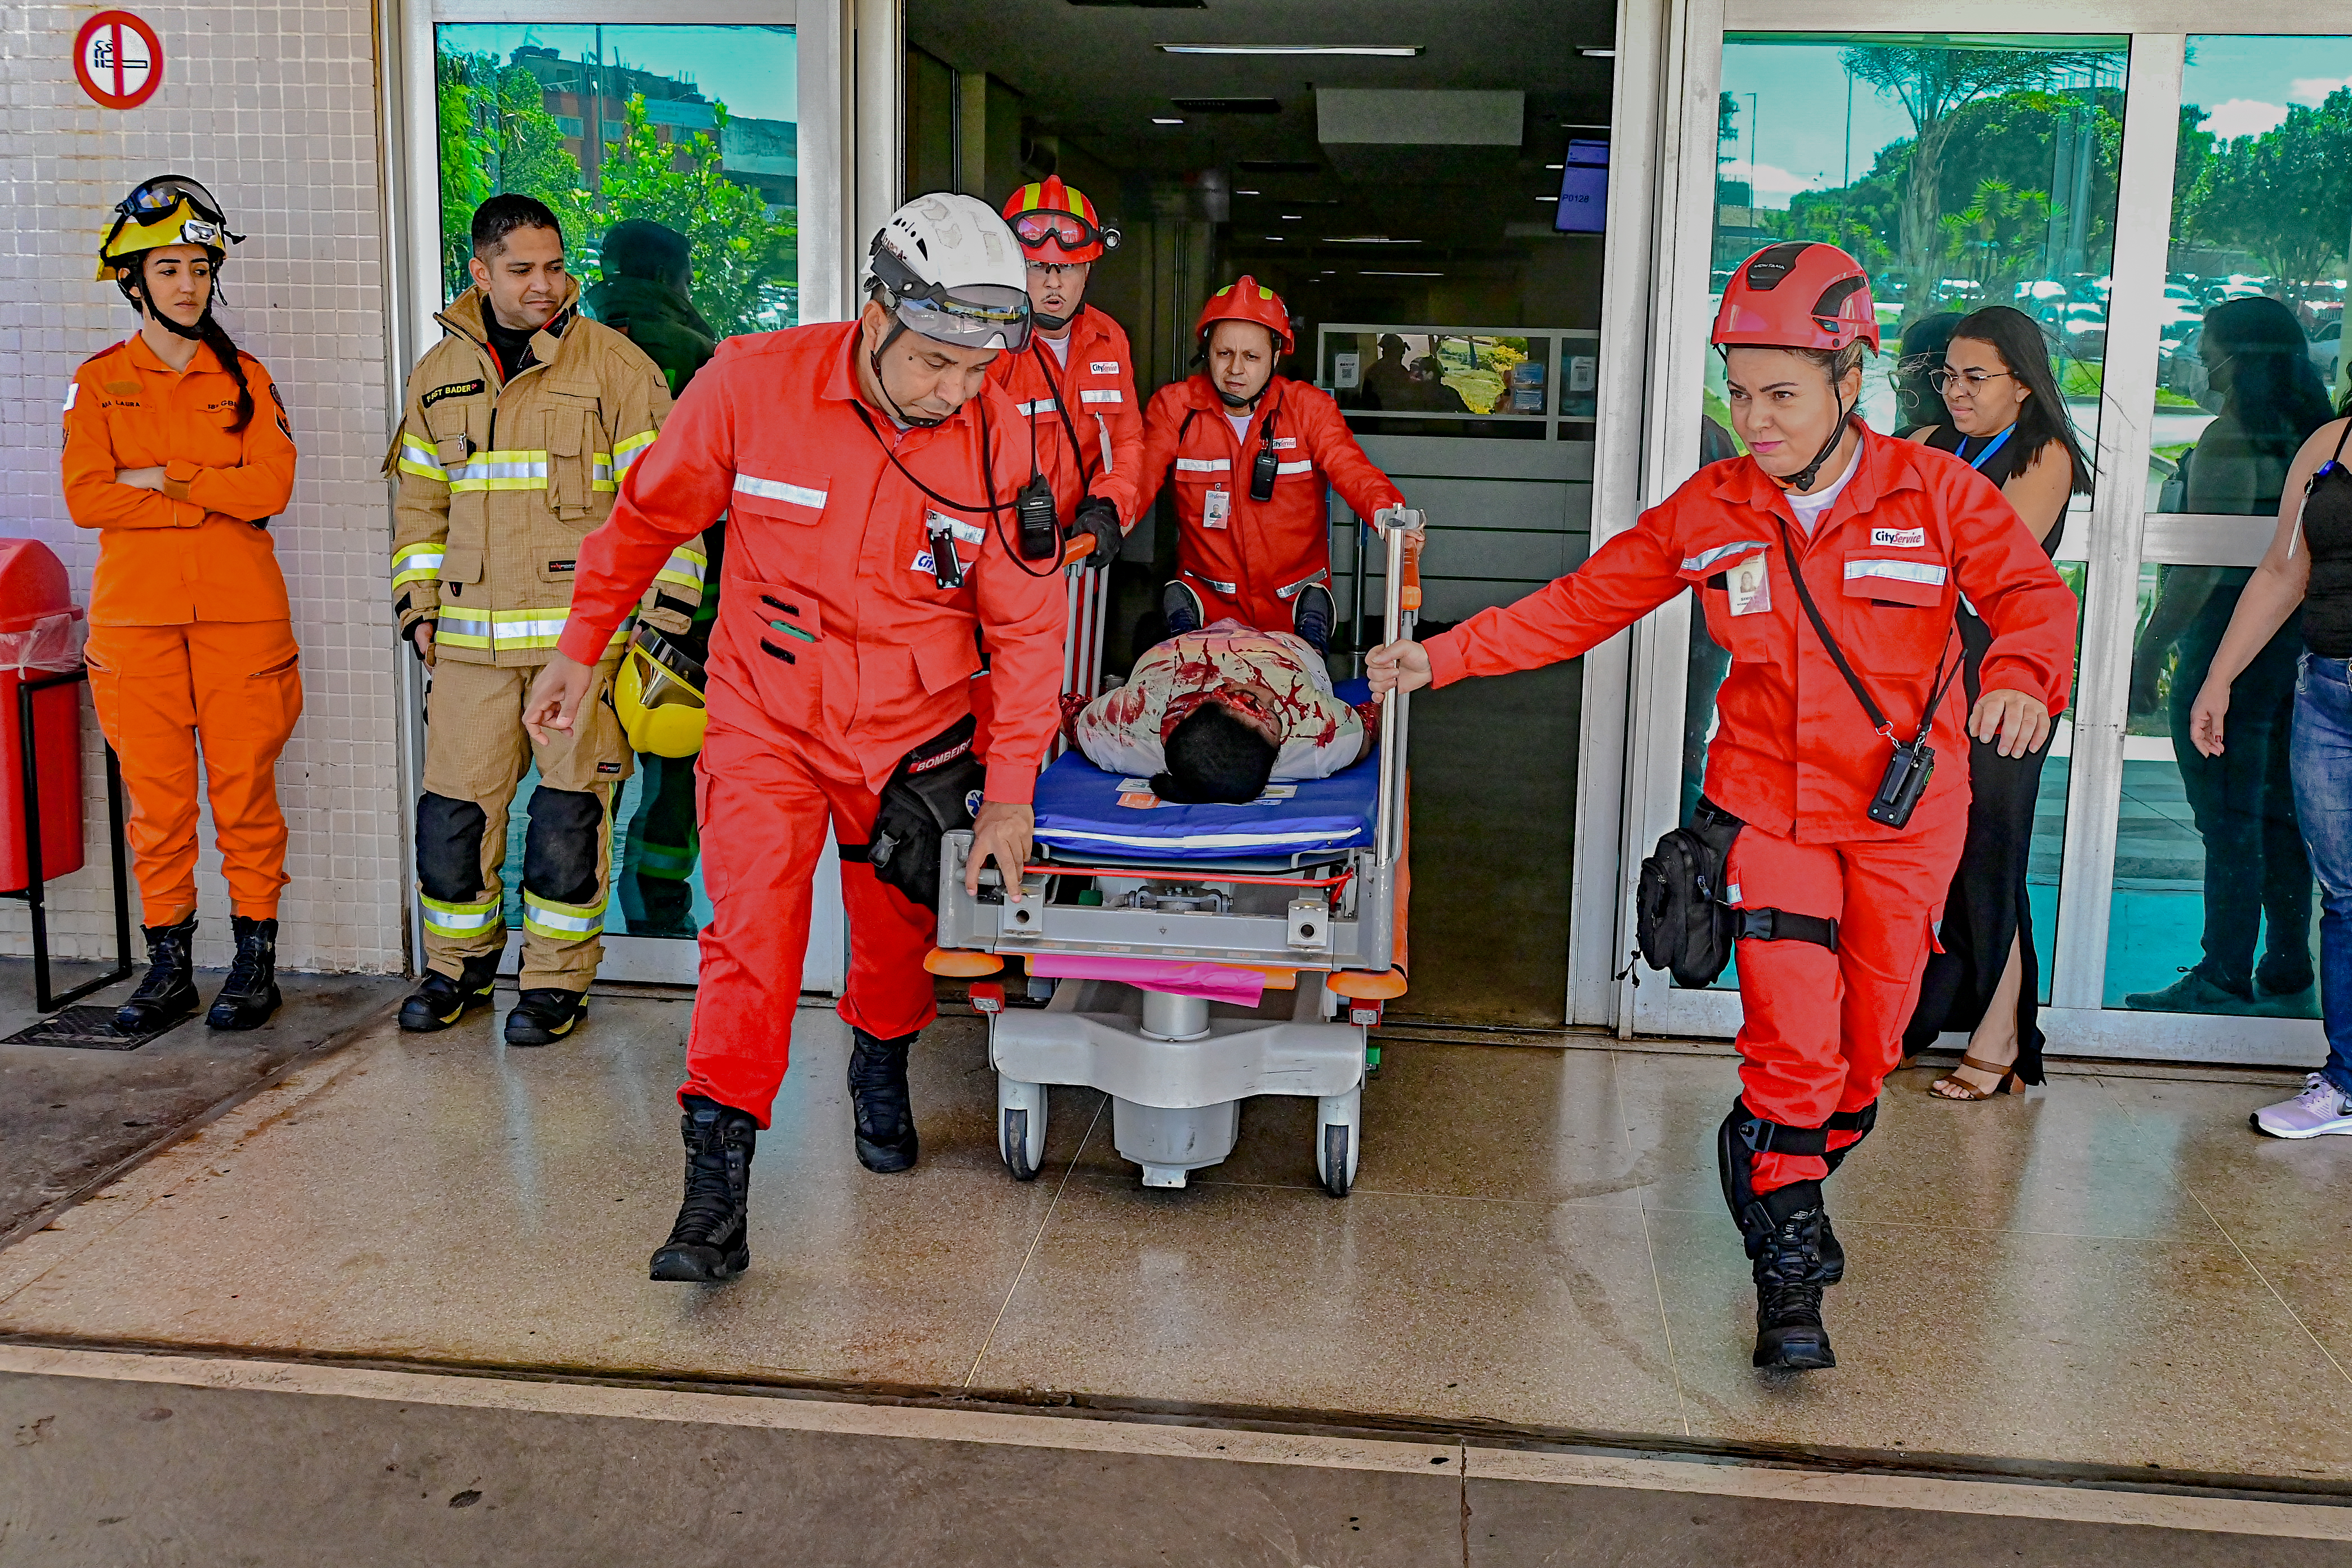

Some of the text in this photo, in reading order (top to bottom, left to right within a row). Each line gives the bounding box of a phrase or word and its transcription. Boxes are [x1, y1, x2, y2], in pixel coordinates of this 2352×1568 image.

[1562, 194, 1589, 203] P0128
[445, 384, 471, 394] BADER
[1273, 439, 1295, 448] ityService
[1875, 531, 1921, 544] CityService
